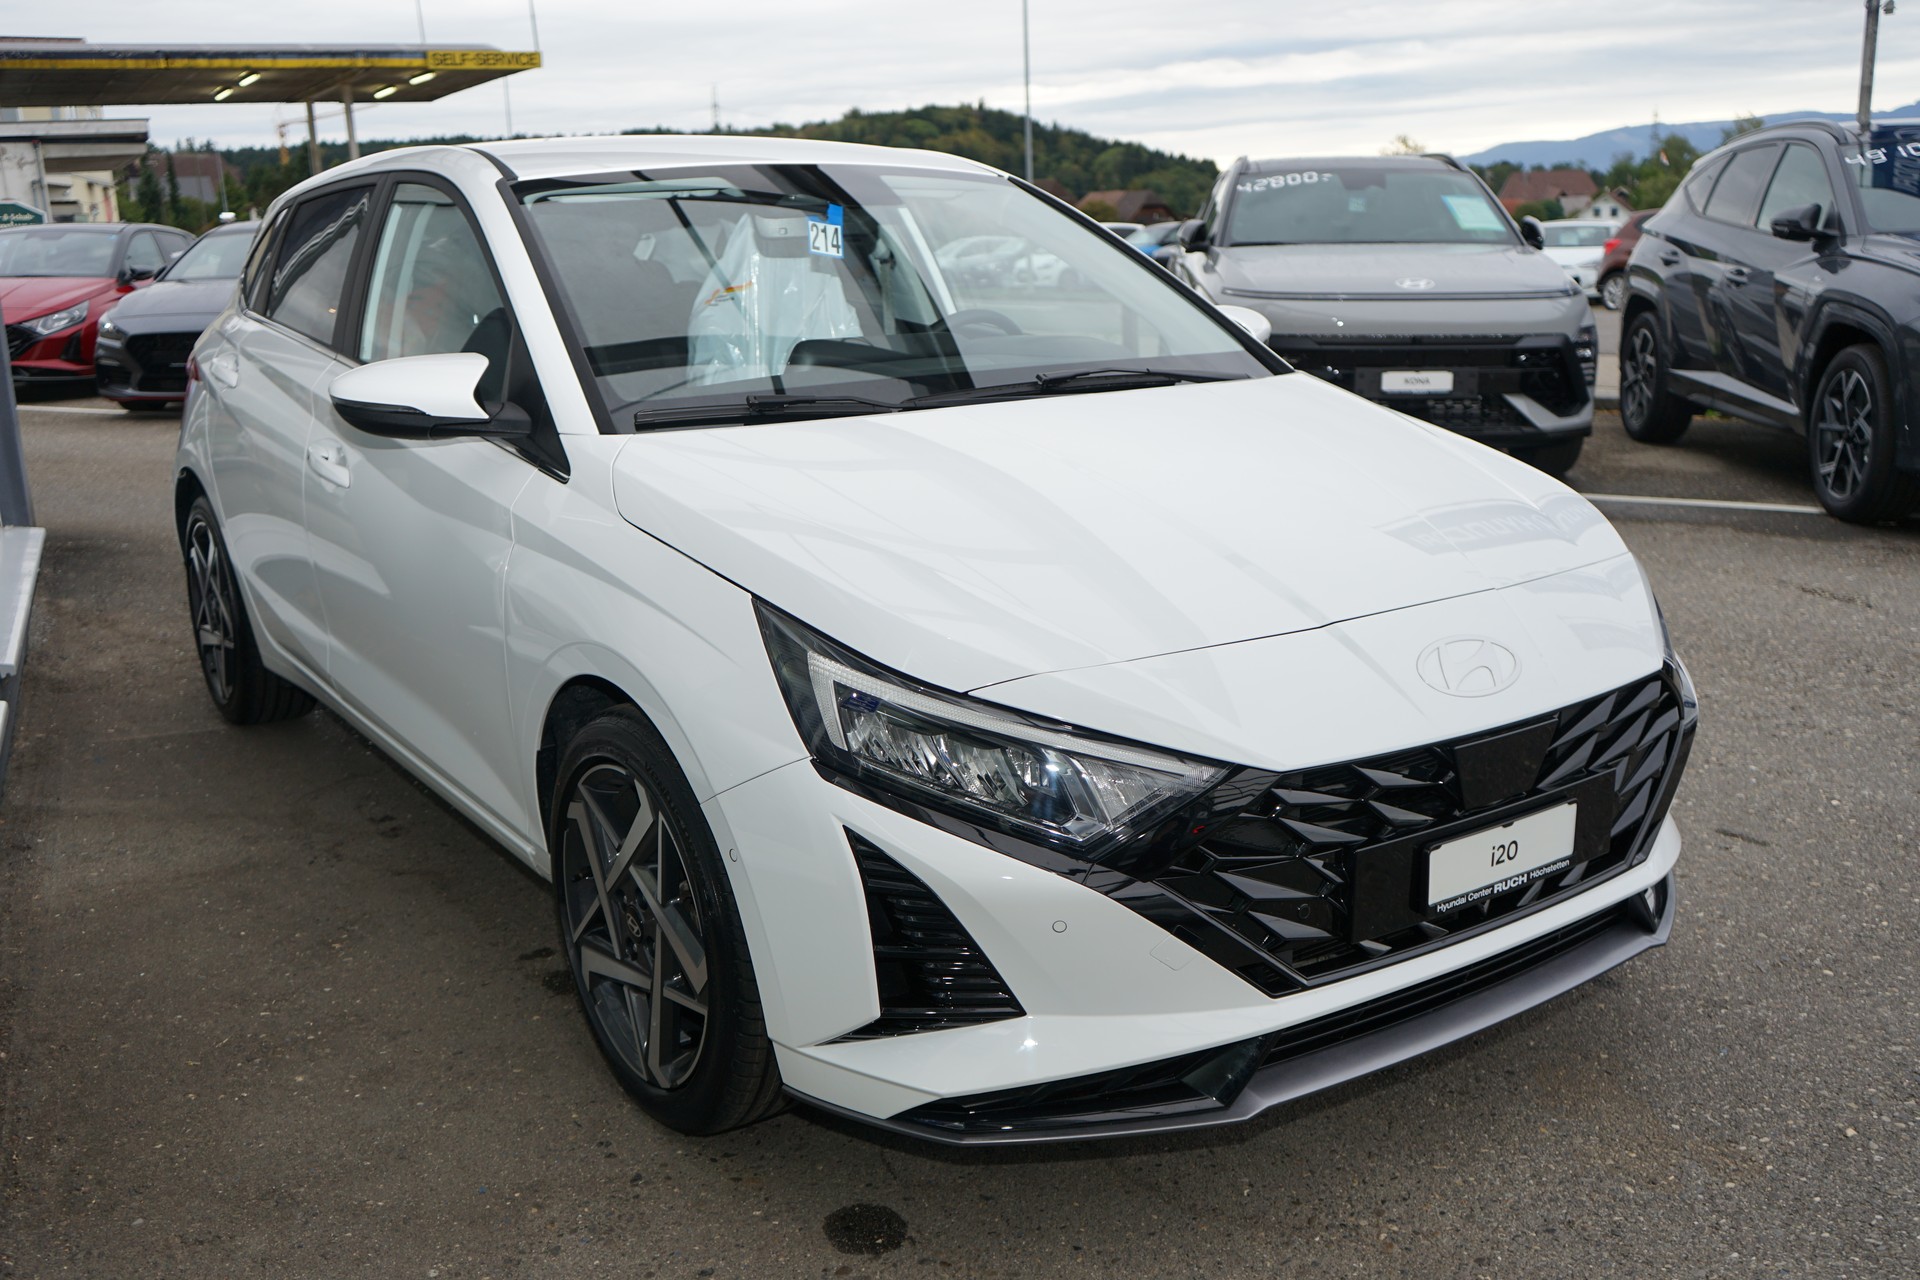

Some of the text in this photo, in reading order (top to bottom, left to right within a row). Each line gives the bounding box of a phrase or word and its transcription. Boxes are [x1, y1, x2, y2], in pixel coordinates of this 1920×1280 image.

[431, 52, 538, 66] SELF-SERVICE
[810, 222, 841, 254] 214
[1404, 377, 1431, 385] KONA
[1490, 840, 1519, 867] i20
[1437, 859, 1570, 913] Hyundai Center RUCH Höchstetten
